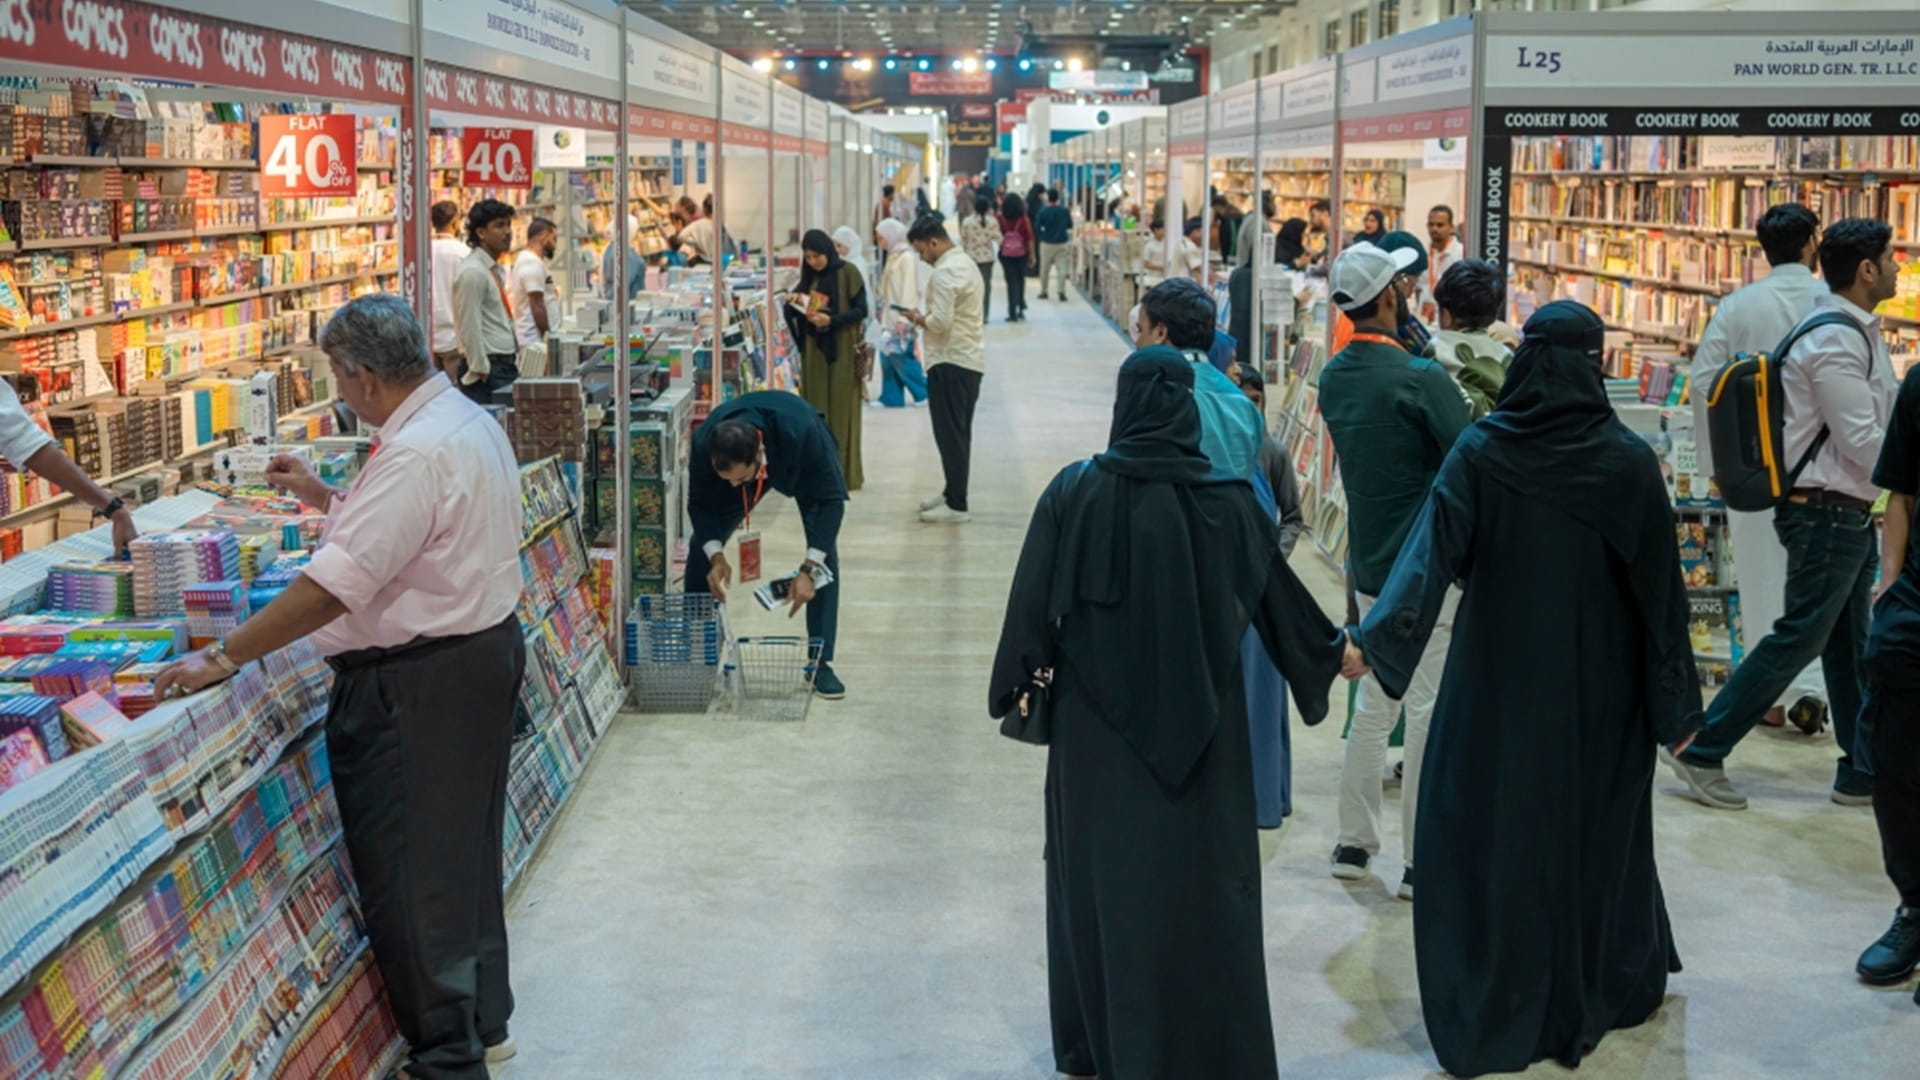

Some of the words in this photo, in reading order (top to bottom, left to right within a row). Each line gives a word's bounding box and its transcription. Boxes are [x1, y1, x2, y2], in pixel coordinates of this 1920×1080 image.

[0, 0, 35, 46] ICS
[62, 0, 128, 59] COMICS
[151, 12, 204, 69] COMICS
[221, 27, 266, 78] COMICS
[281, 38, 319, 85] COMICS
[332, 49, 364, 91] COMICS
[375, 56, 406, 96] COMICS
[1766, 40, 1813, 54] المتحدة
[1817, 39, 1858, 56] العربية
[1861, 39, 1914, 55] الإمارات
[1734, 63, 1763, 76] PAN
[1768, 63, 1820, 76] WORLD
[1823, 63, 1857, 76] GEN.
[1861, 63, 1882, 75] TR.
[289, 115, 327, 130] FLAT
[1505, 113, 1566, 128] COOKERY
[1570, 113, 1608, 128] BOOK
[1636, 113, 1698, 128] COOKERY
[1701, 113, 1740, 128] BOOK
[1768, 113, 1829, 128] COOKERY
[1833, 113, 1872, 128] BOOK
[484, 129, 512, 140] FLAT
[265, 134, 341, 188] 40
[466, 141, 522, 182] 40
[331, 175, 352, 187] OFF
[403, 127, 414, 222] COMICS
[1488, 166, 1503, 208] BOOK
[1486, 212, 1501, 265] OOKERY
